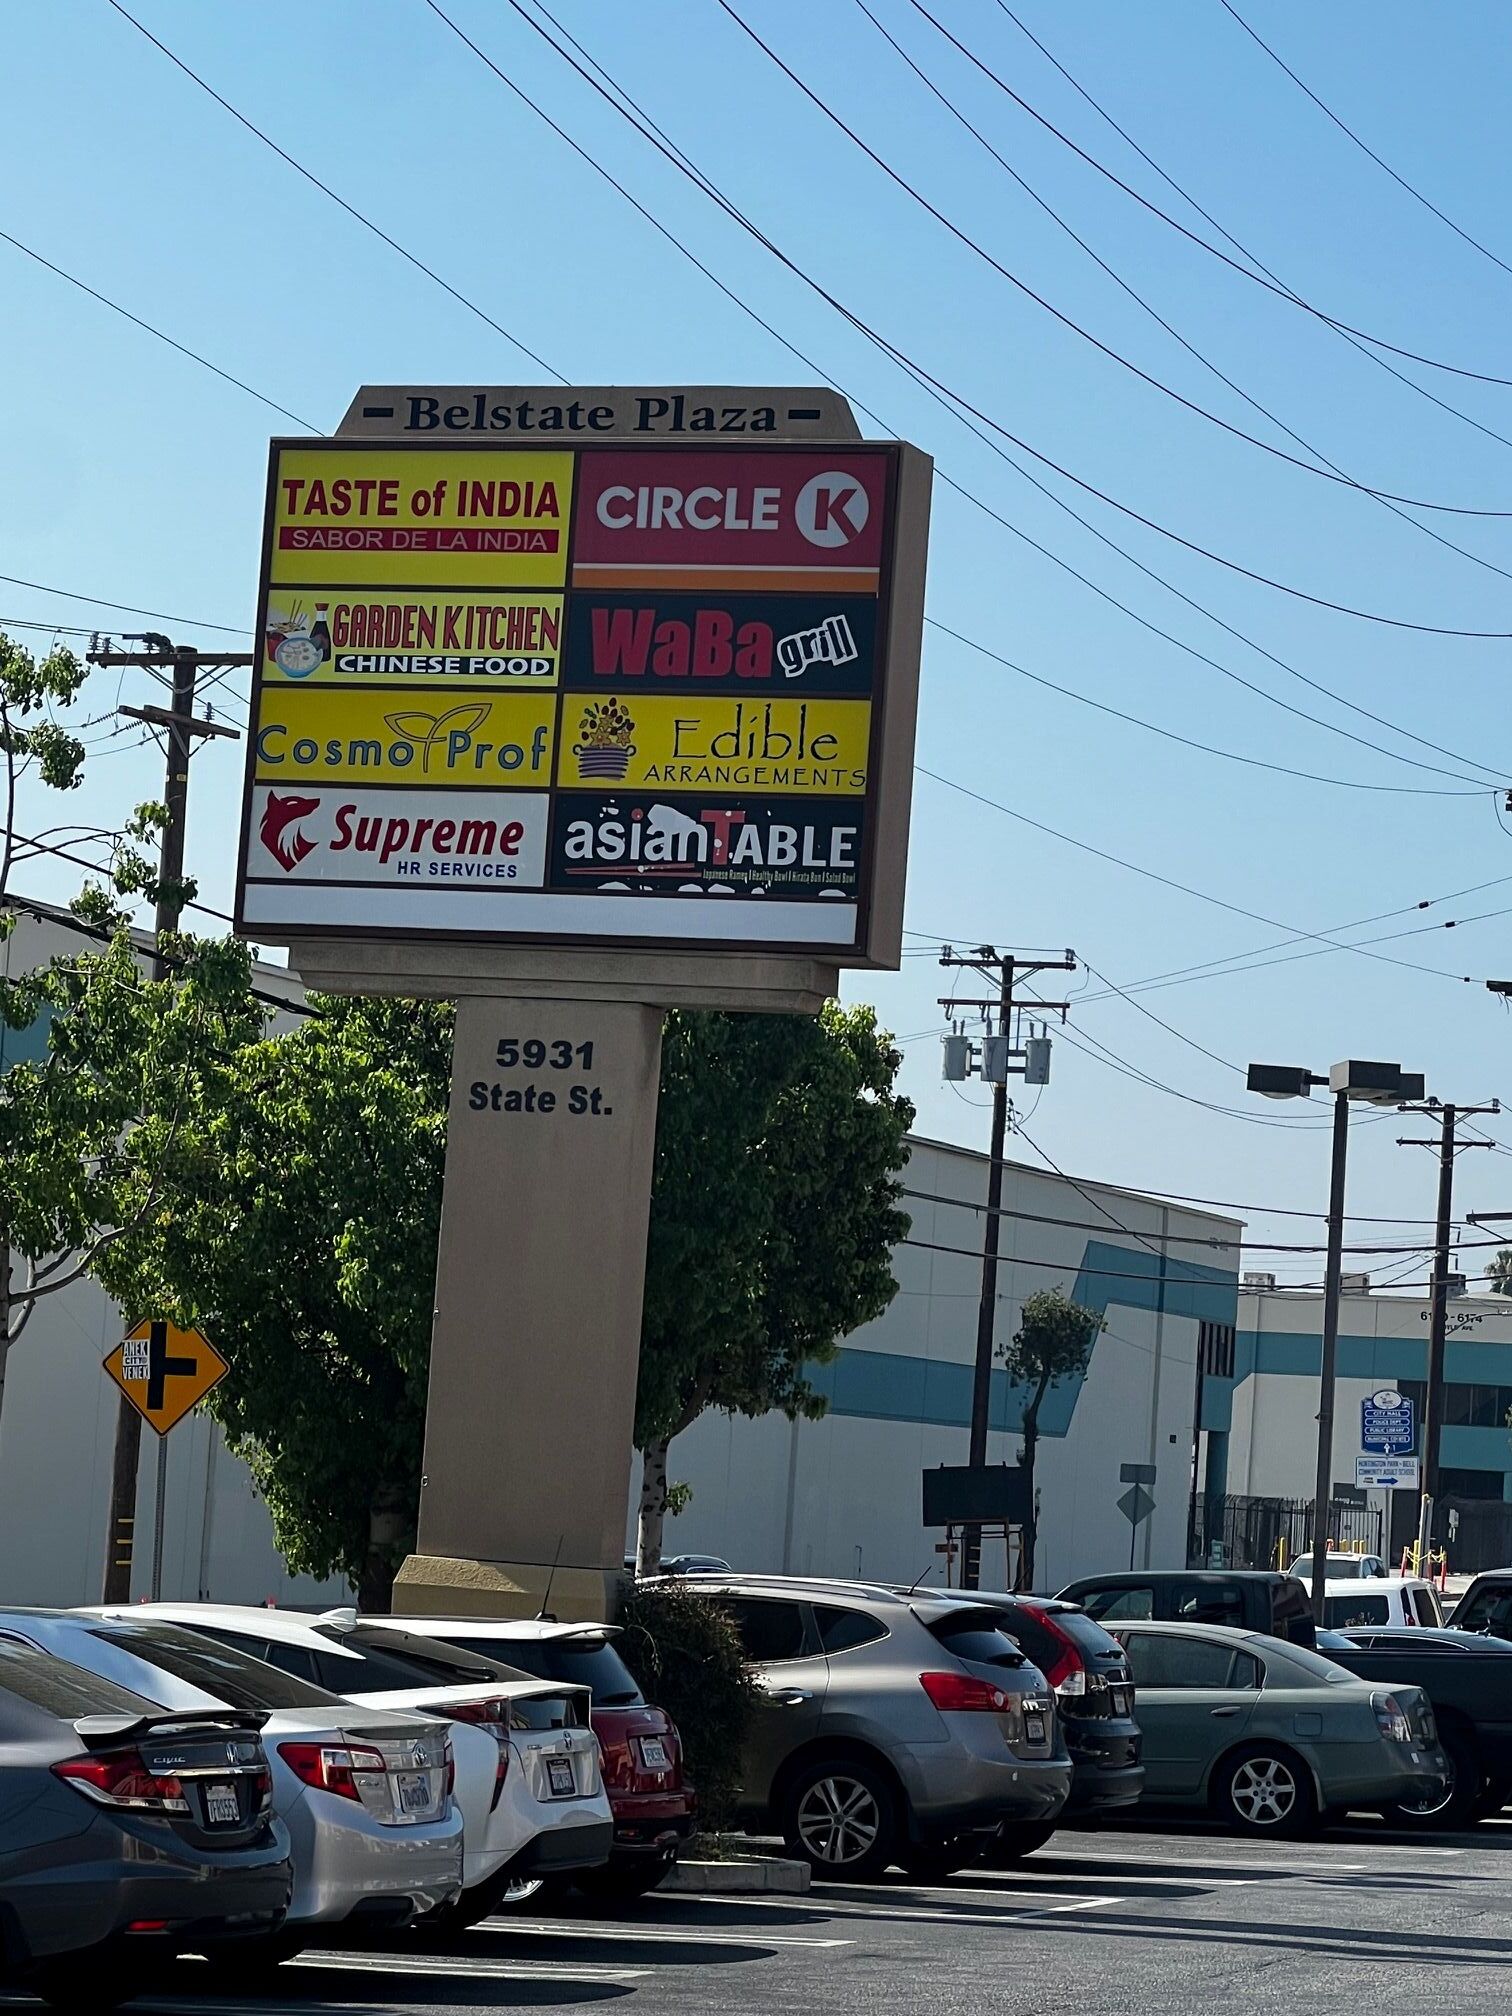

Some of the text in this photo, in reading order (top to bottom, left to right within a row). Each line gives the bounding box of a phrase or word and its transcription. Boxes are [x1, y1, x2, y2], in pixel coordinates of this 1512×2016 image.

[404, 394, 777, 432] Belstate Plaza
[282, 479, 560, 518] TASTE of INDIA
[597, 485, 781, 530] CIRCLE
[292, 529, 548, 551] SABOR DE LA INDIA
[332, 604, 561, 651] GARDEN KITCHEN
[591, 608, 858, 678] WaBa grill
[339, 655, 550, 676] CHINESE FOOD
[256, 724, 548, 771] Cosmo Prof
[672, 703, 838, 761] Edible
[643, 763, 866, 787] ARRANGEMENTS
[329, 803, 525, 864] Supreme
[397, 861, 517, 878] HR SERVICES
[496, 1038, 594, 1071] 5931
[468, 1081, 613, 1115] State St.
